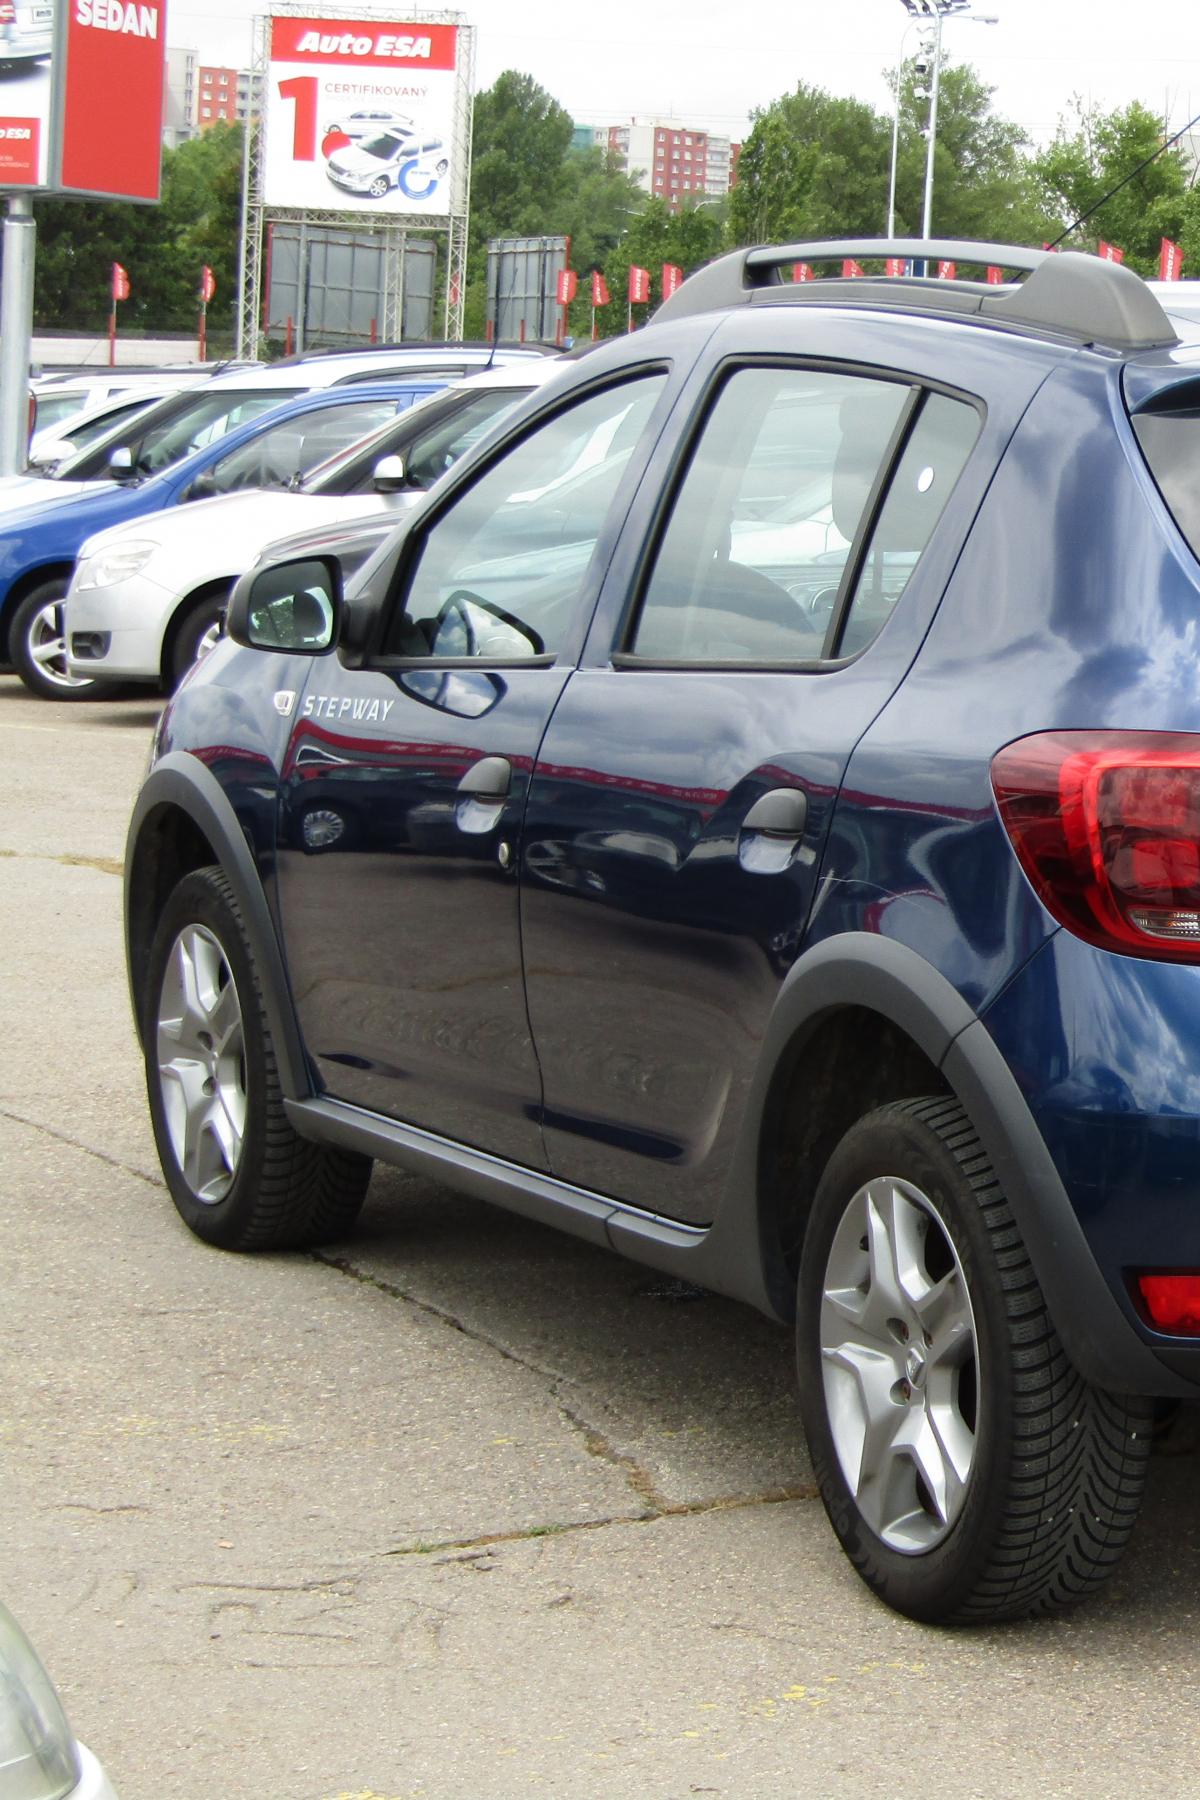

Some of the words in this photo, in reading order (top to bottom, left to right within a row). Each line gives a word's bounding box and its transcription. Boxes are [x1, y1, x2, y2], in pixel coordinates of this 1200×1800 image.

[77, 0, 158, 39] SEDAN
[296, 31, 372, 55] Auto
[373, 35, 431, 58] ESA
[325, 83, 428, 97] CERTIFIKOVANÝ
[6, 128, 31, 139] ESA
[303, 696, 395, 721] STEPWAY
